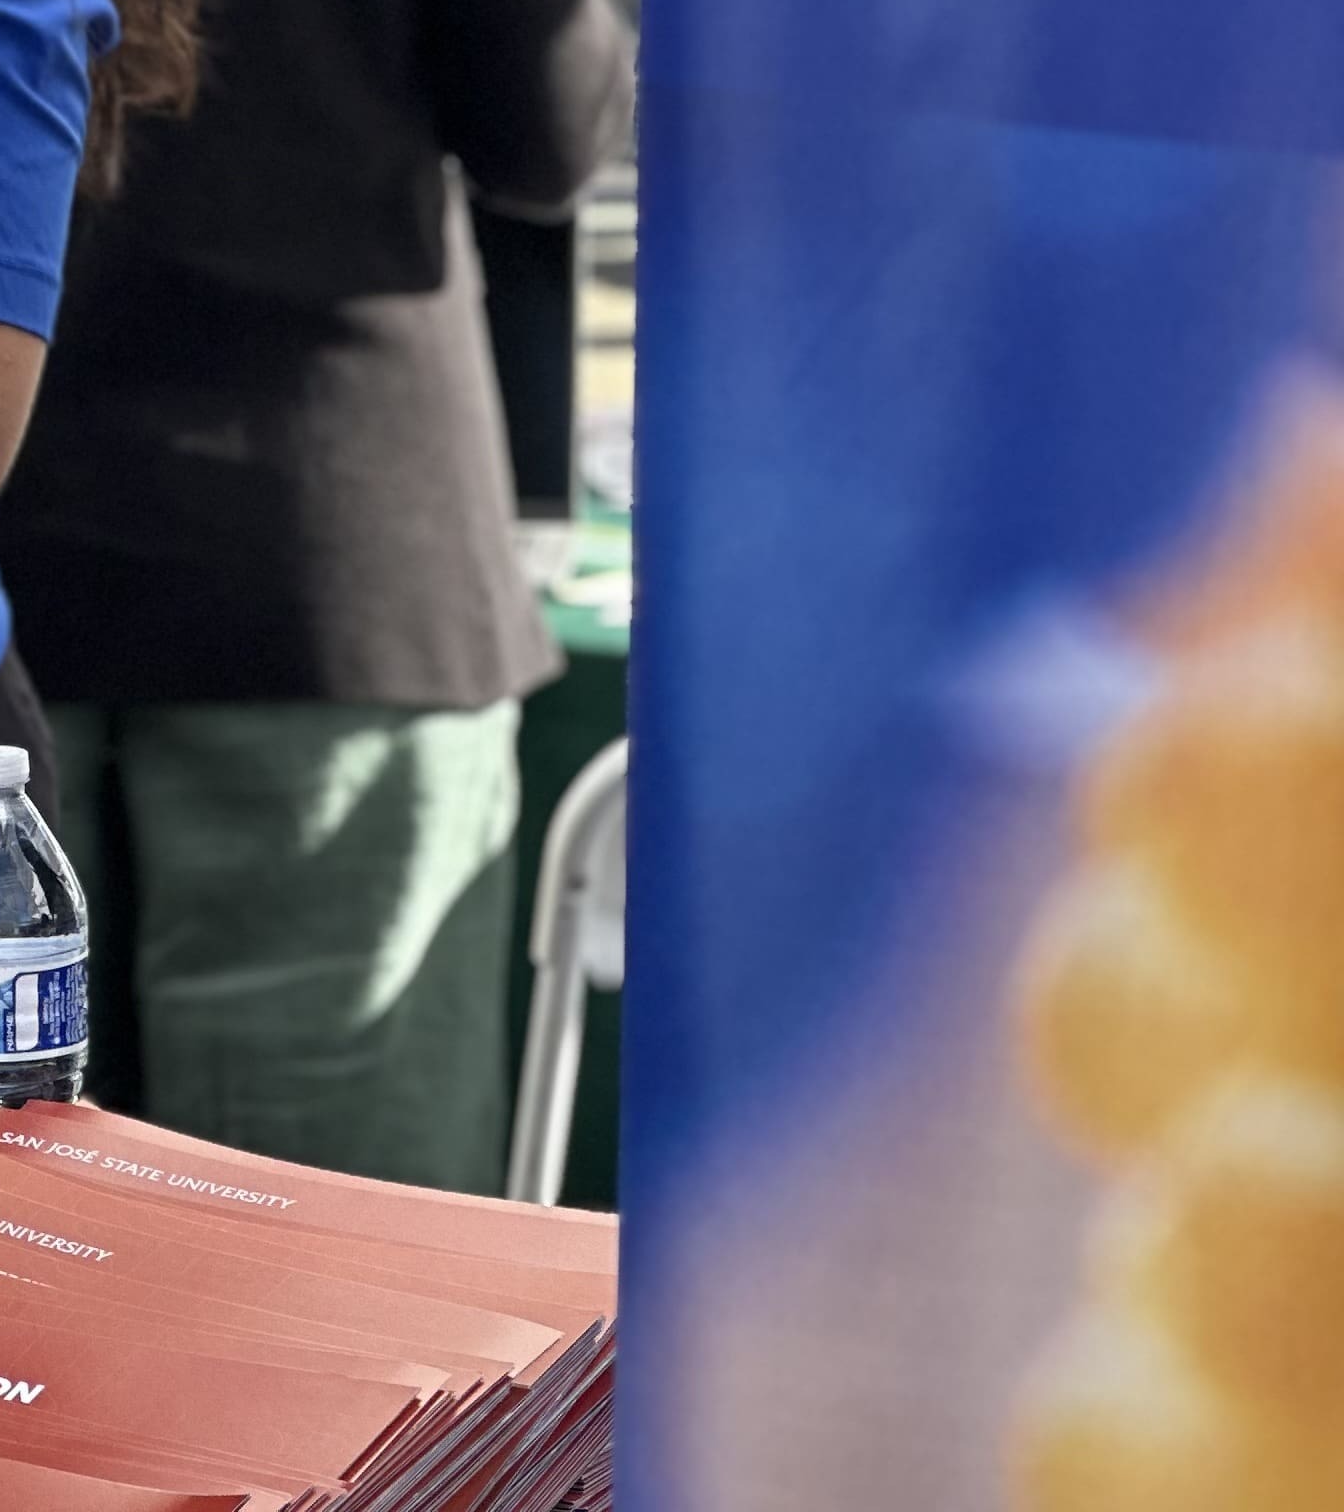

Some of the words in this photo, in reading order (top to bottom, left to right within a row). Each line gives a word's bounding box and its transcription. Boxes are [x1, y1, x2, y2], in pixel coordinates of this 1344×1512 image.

[44, 1142, 99, 1164] JOSÉ
[99, 1155, 165, 1181] STATE
[168, 1175, 298, 1210] UNIVERSITY
